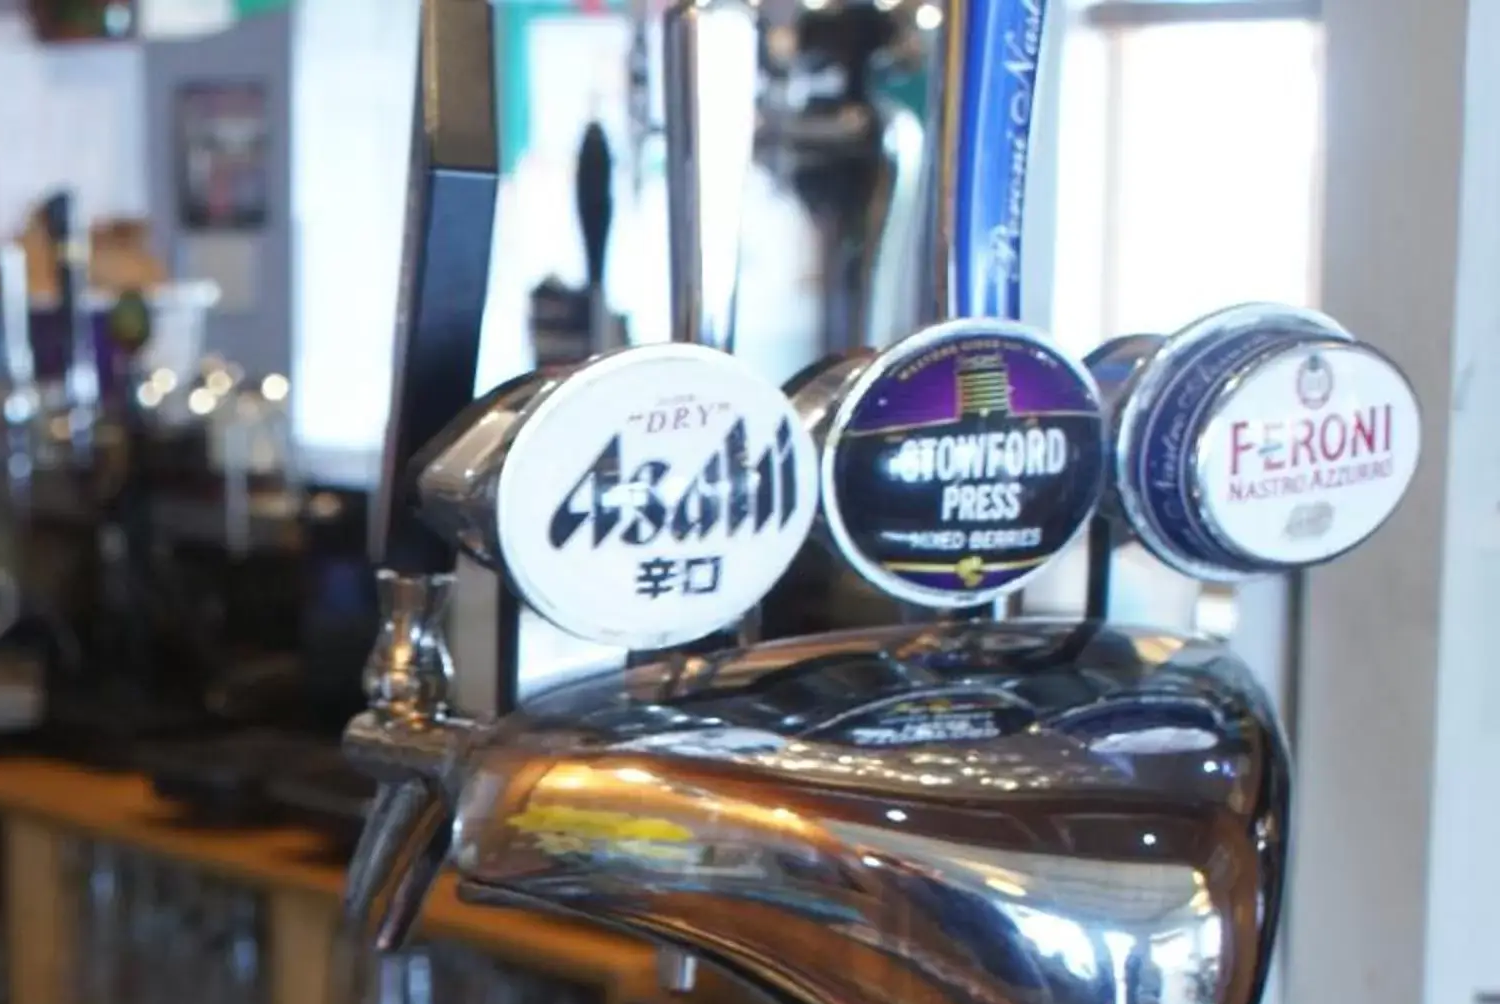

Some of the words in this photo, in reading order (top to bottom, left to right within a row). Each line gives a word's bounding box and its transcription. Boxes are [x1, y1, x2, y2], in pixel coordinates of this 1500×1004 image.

[899, 428, 1067, 483] STOWFORD
[547, 414, 798, 549] Asahi
[941, 482, 1023, 522] PRESS
[635, 555, 723, 599] 辛口
